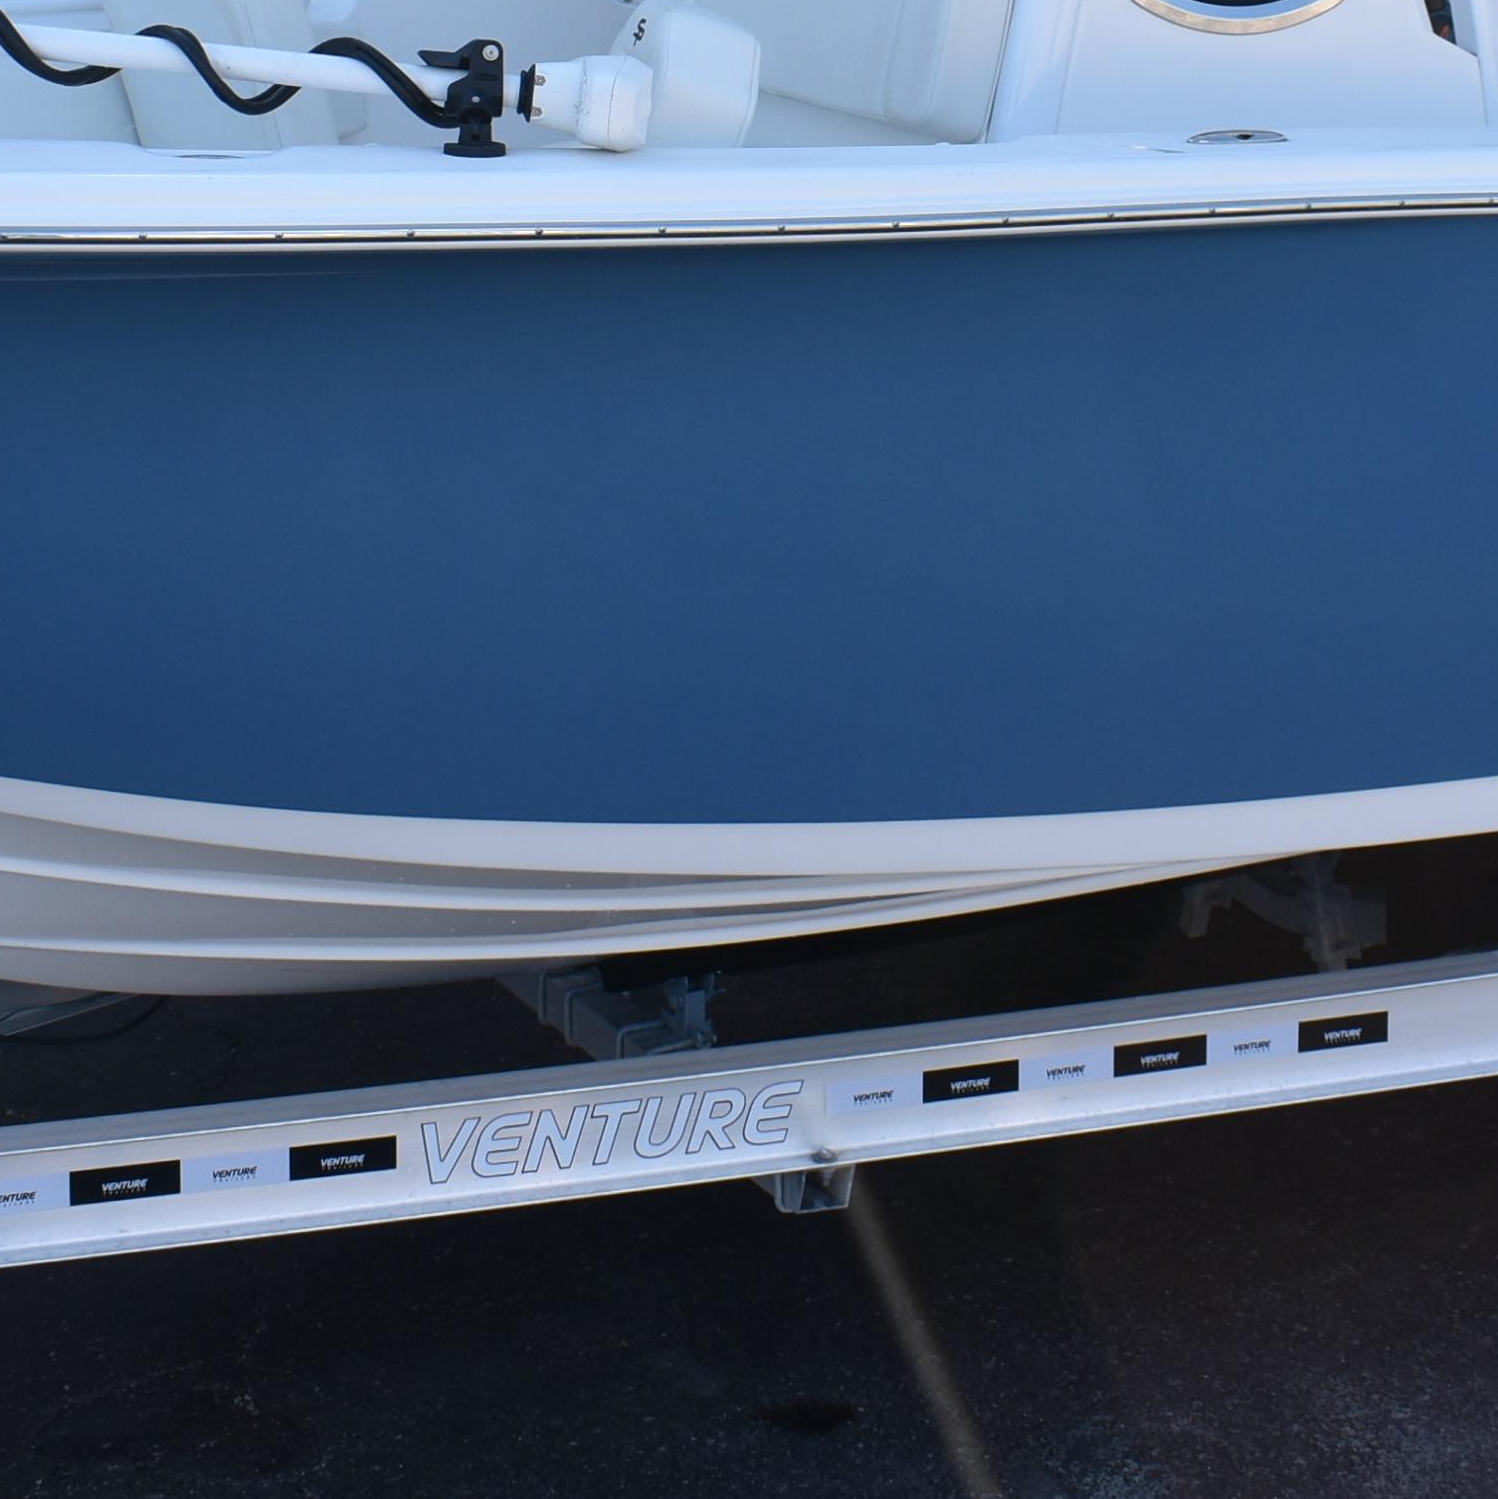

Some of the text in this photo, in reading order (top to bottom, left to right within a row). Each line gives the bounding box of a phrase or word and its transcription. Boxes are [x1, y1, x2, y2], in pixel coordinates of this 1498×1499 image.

[1140, 1051, 1180, 1065] VENTURE
[1046, 1064, 1086, 1077] VENTURE
[950, 1076, 991, 1090] VENTURE
[853, 1090, 894, 1102] VENTURE
[420, 1079, 805, 1185] VENTURE
[320, 1154, 366, 1167] VENTURE
[212, 1165, 258, 1179] VENTURE
[101, 1178, 149, 1191] VENTURE
